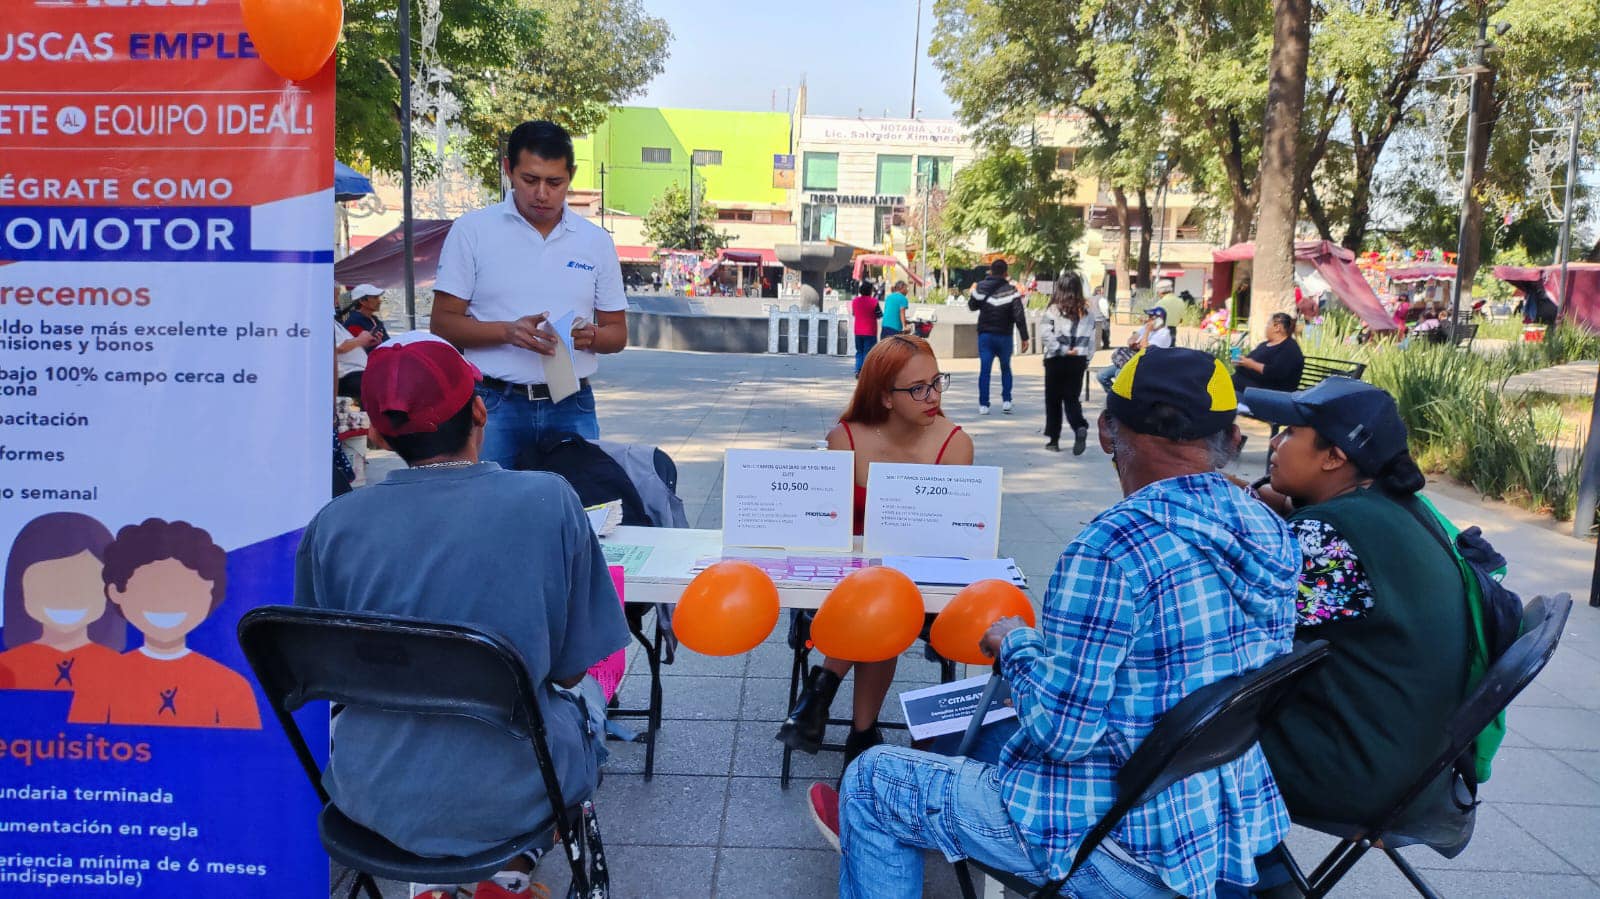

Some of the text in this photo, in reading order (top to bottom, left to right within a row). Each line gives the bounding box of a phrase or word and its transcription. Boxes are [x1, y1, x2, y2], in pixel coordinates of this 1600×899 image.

[0, 105, 313, 135] ETE AL EQUIPO IDEAL!
[880, 124, 925, 133] NOTARIA
[824, 130, 847, 138] Lic.
[851, 131, 902, 141] Salvador
[0, 174, 233, 199] ÉGRATE COMO
[810, 194, 905, 205] RESTAURANTE
[0, 217, 235, 251] OMOTOR
[1, 285, 151, 306] recemos
[0, 320, 311, 341] ldo base más excelente plan de
[79, 340, 89, 355] y
[97, 336, 154, 352] bonos
[46, 366, 98, 382] 100%
[105, 369, 167, 386] campo
[174, 371, 225, 384] cerca
[232, 369, 258, 384] de
[0, 385, 37, 396] ona
[0, 446, 65, 462] formes
[21, 487, 97, 501] semanal
[771, 481, 808, 492] $10,500
[915, 485, 948, 496] $7,200
[74, 787, 173, 804] terminada
[0, 819, 198, 841] umentación en regla
[80, 855, 150, 870] mínima
[157, 856, 180, 871] de
[188, 859, 199, 872] 6
[207, 862, 266, 876] meses
[1, 868, 142, 888] indispensable)
